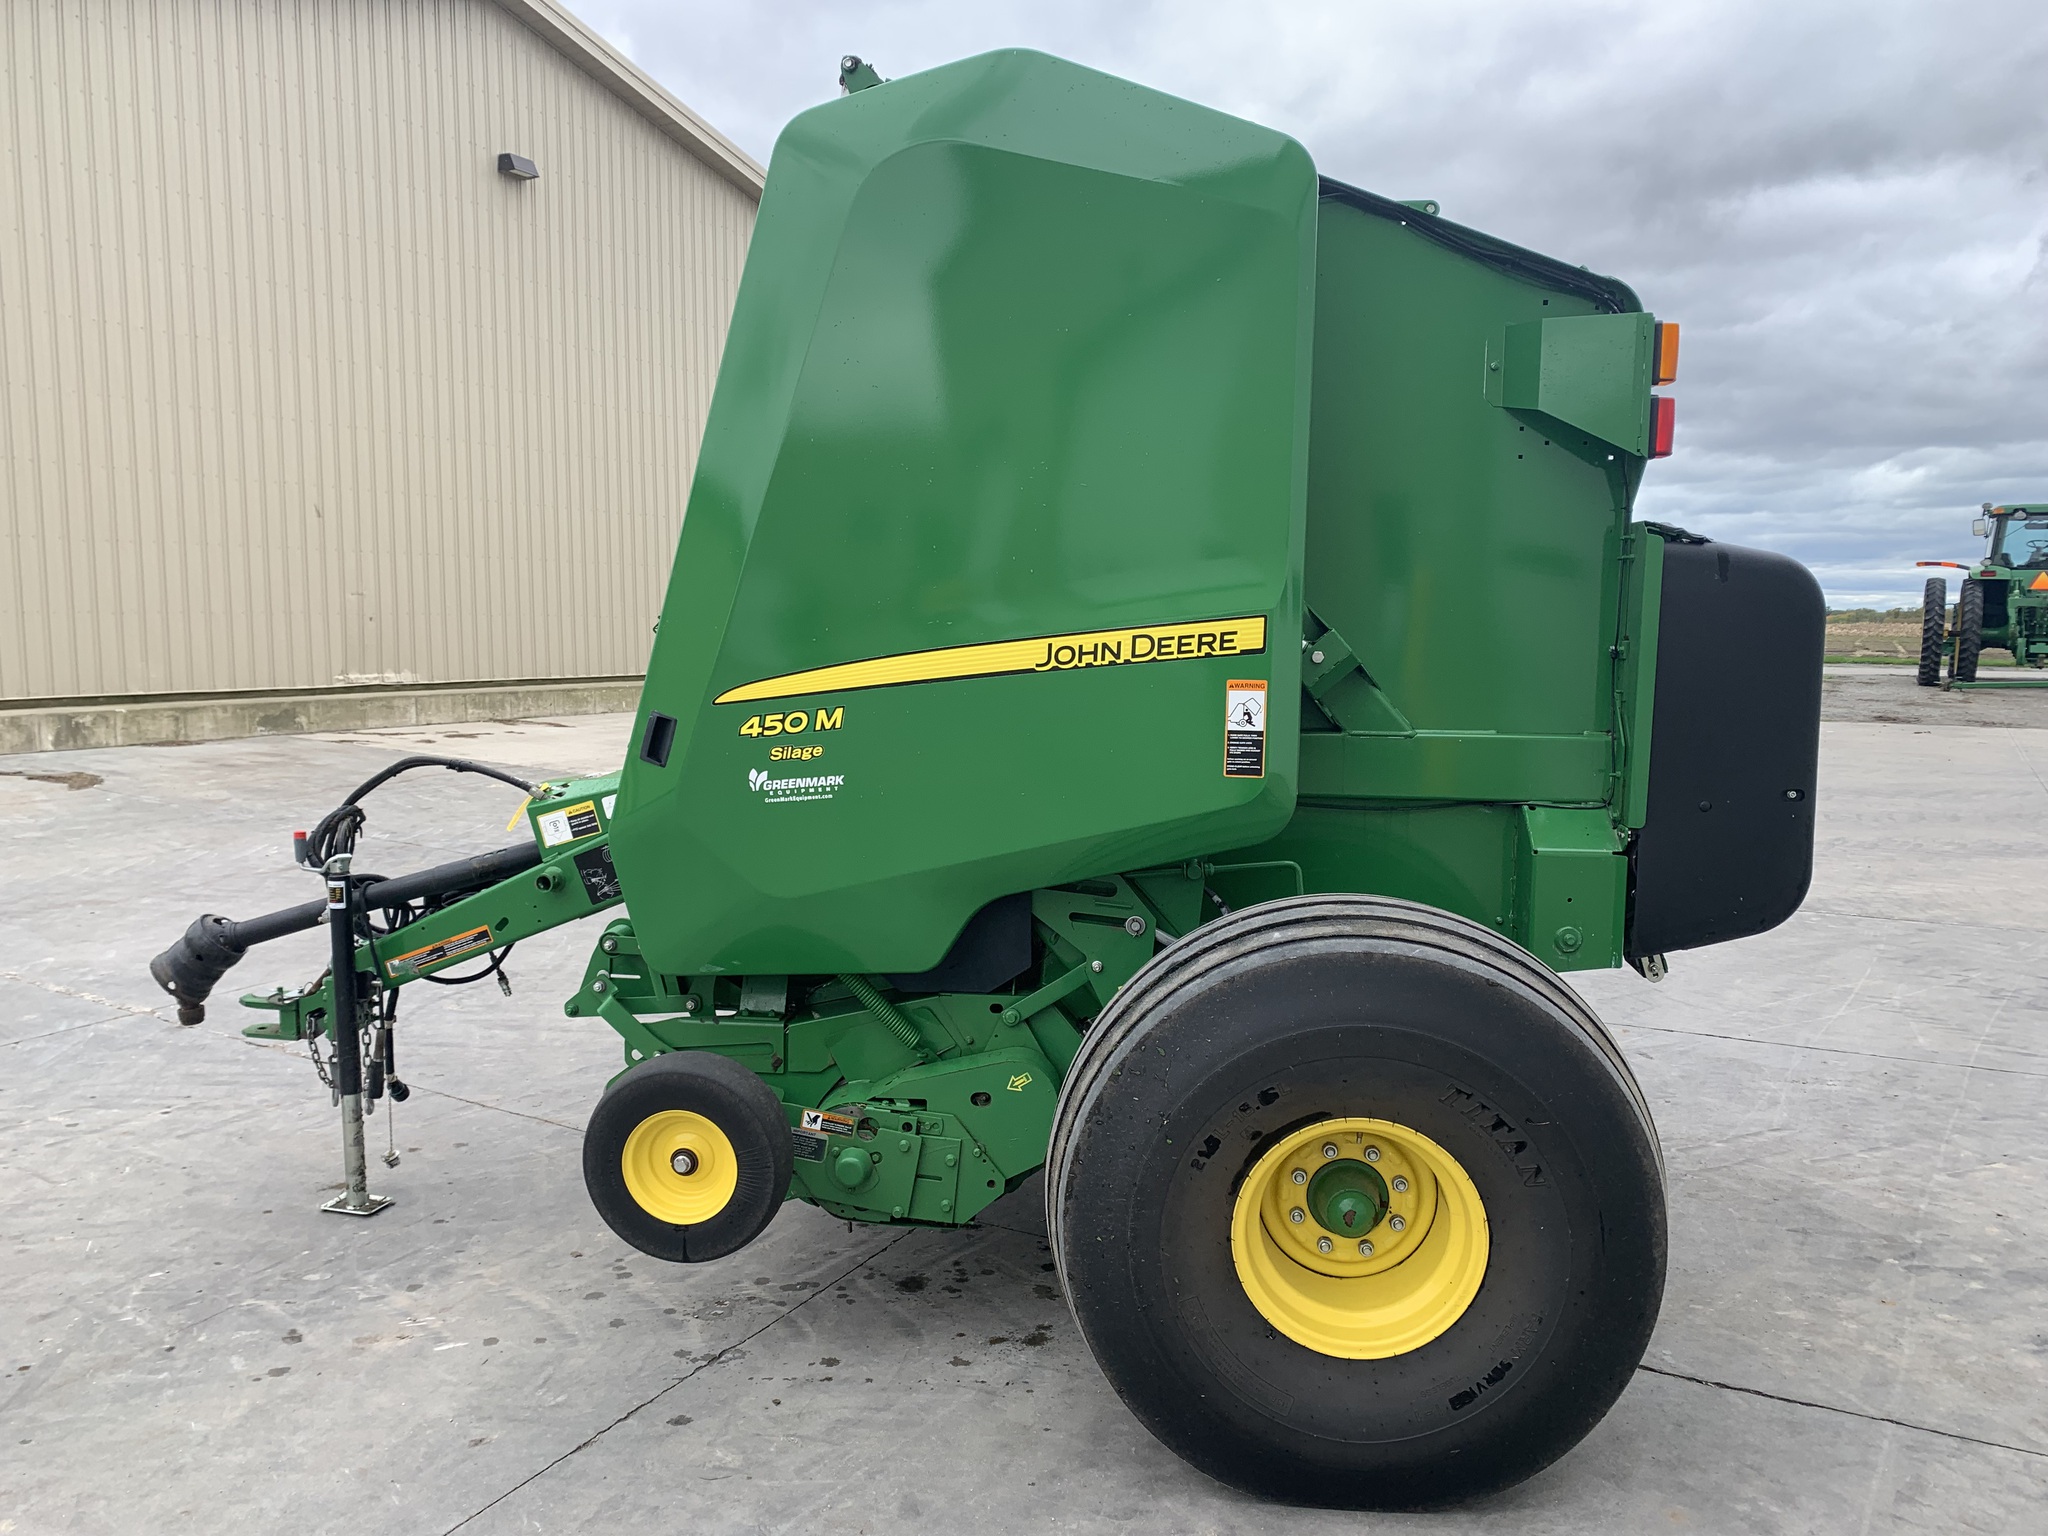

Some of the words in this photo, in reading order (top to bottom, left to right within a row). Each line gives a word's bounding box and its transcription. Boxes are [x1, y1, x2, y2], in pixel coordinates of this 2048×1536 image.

[1036, 640, 1122, 668] JOHN
[1131, 631, 1238, 658] DEERE
[738, 710, 808, 738] 450
[814, 706, 844, 732] M
[769, 745, 824, 761] Silage
[763, 775, 844, 790] GREENMARK
[764, 794, 833, 804] GreenMarkEquipment.com
[769, 786, 839, 796] EQUIPMENT
[572, 805, 590, 813] CAUTION
[1438, 1082, 1551, 1189] TITAN
[1510, 1312, 1544, 1360] FARM
